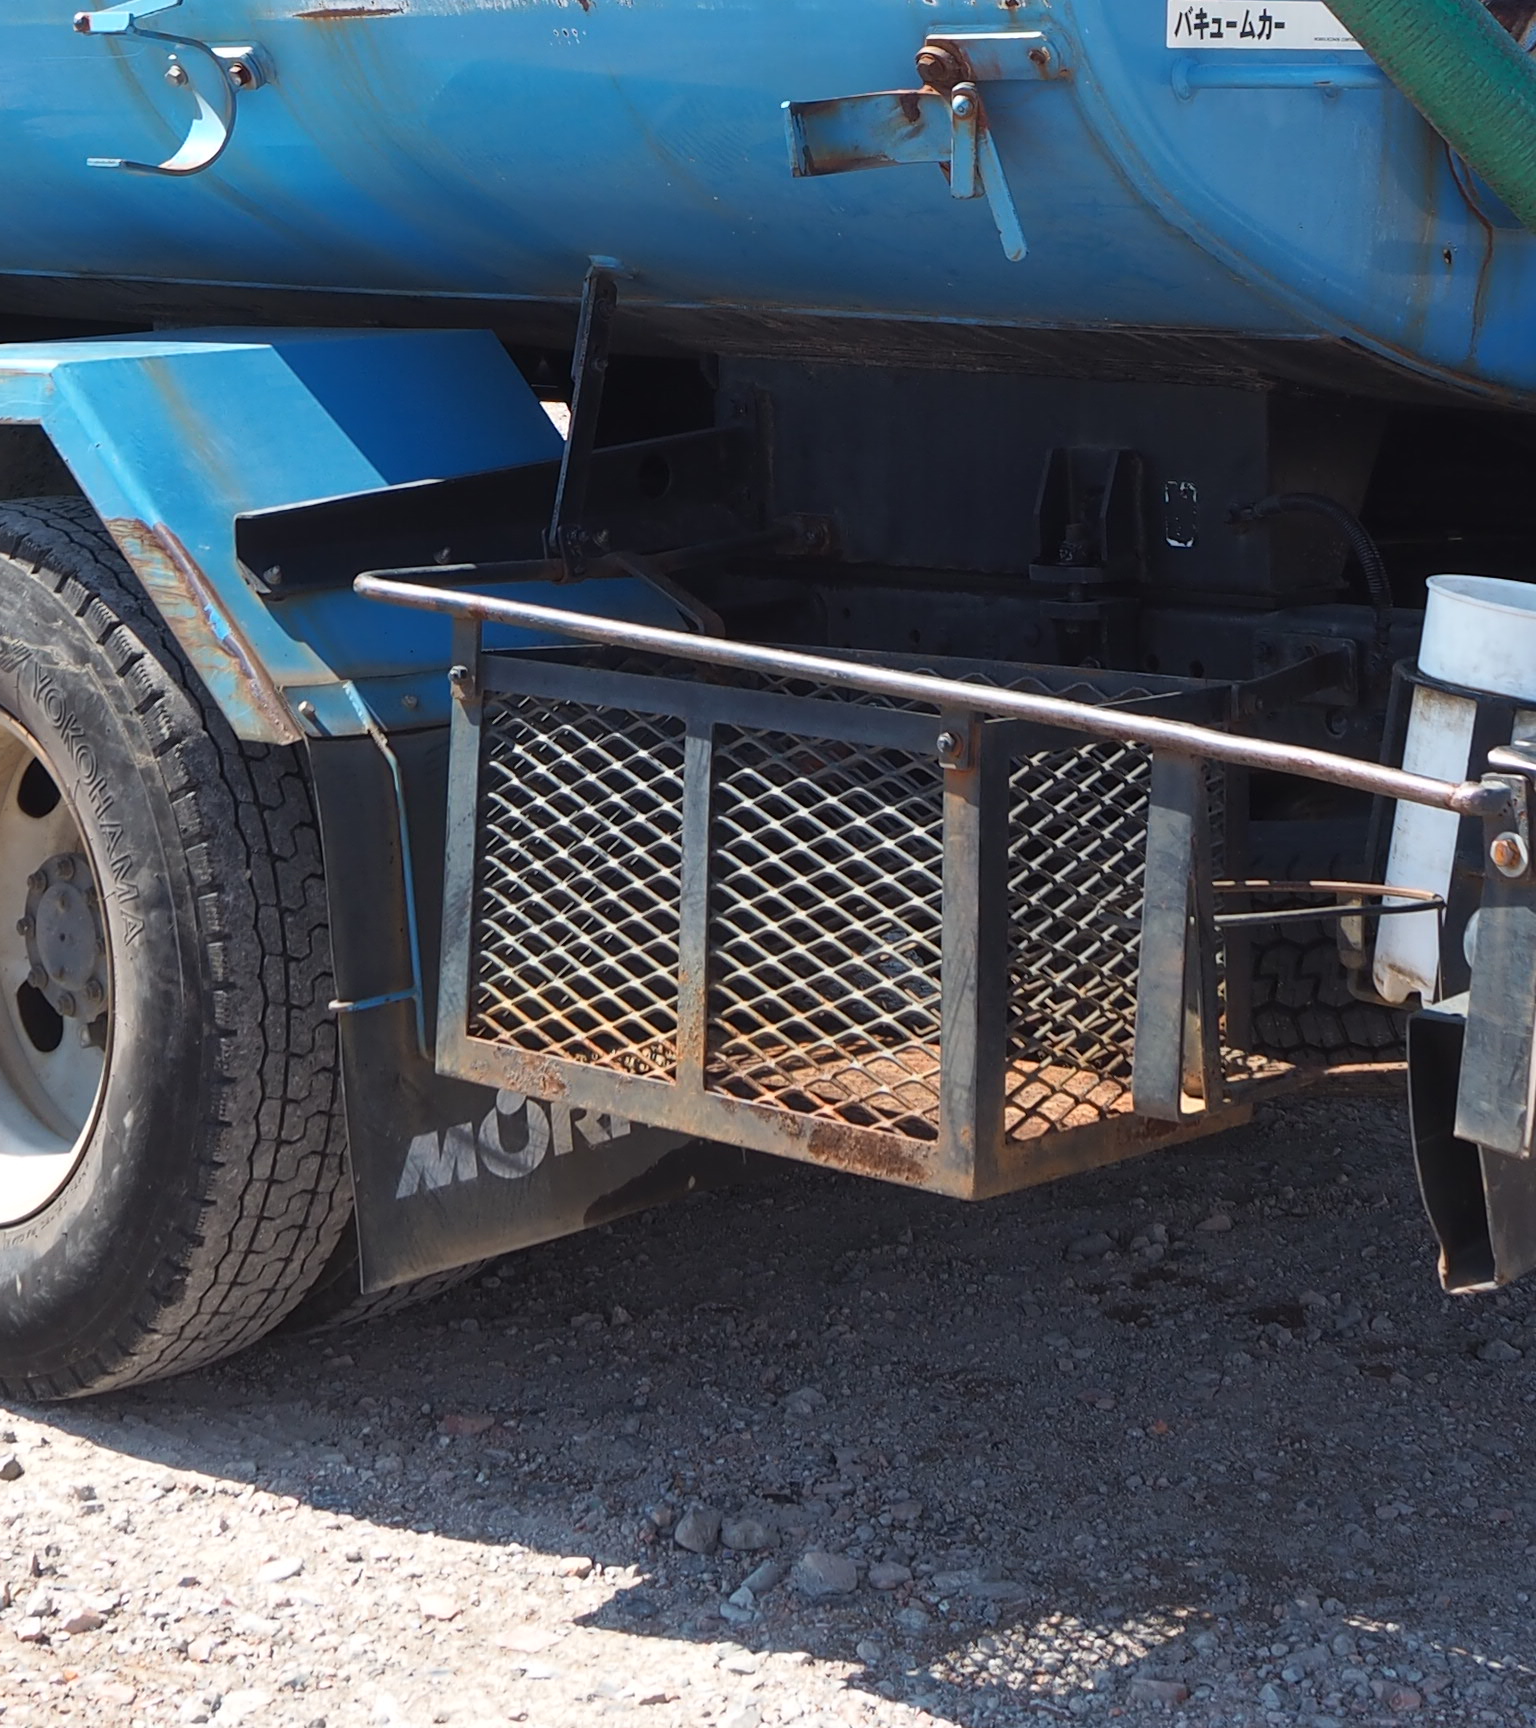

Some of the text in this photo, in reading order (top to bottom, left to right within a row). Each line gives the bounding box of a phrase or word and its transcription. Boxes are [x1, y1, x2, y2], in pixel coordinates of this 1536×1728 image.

[1174, 6, 1286, 40] バキュームカー
[32, 661, 145, 947] YOKOHAMA
